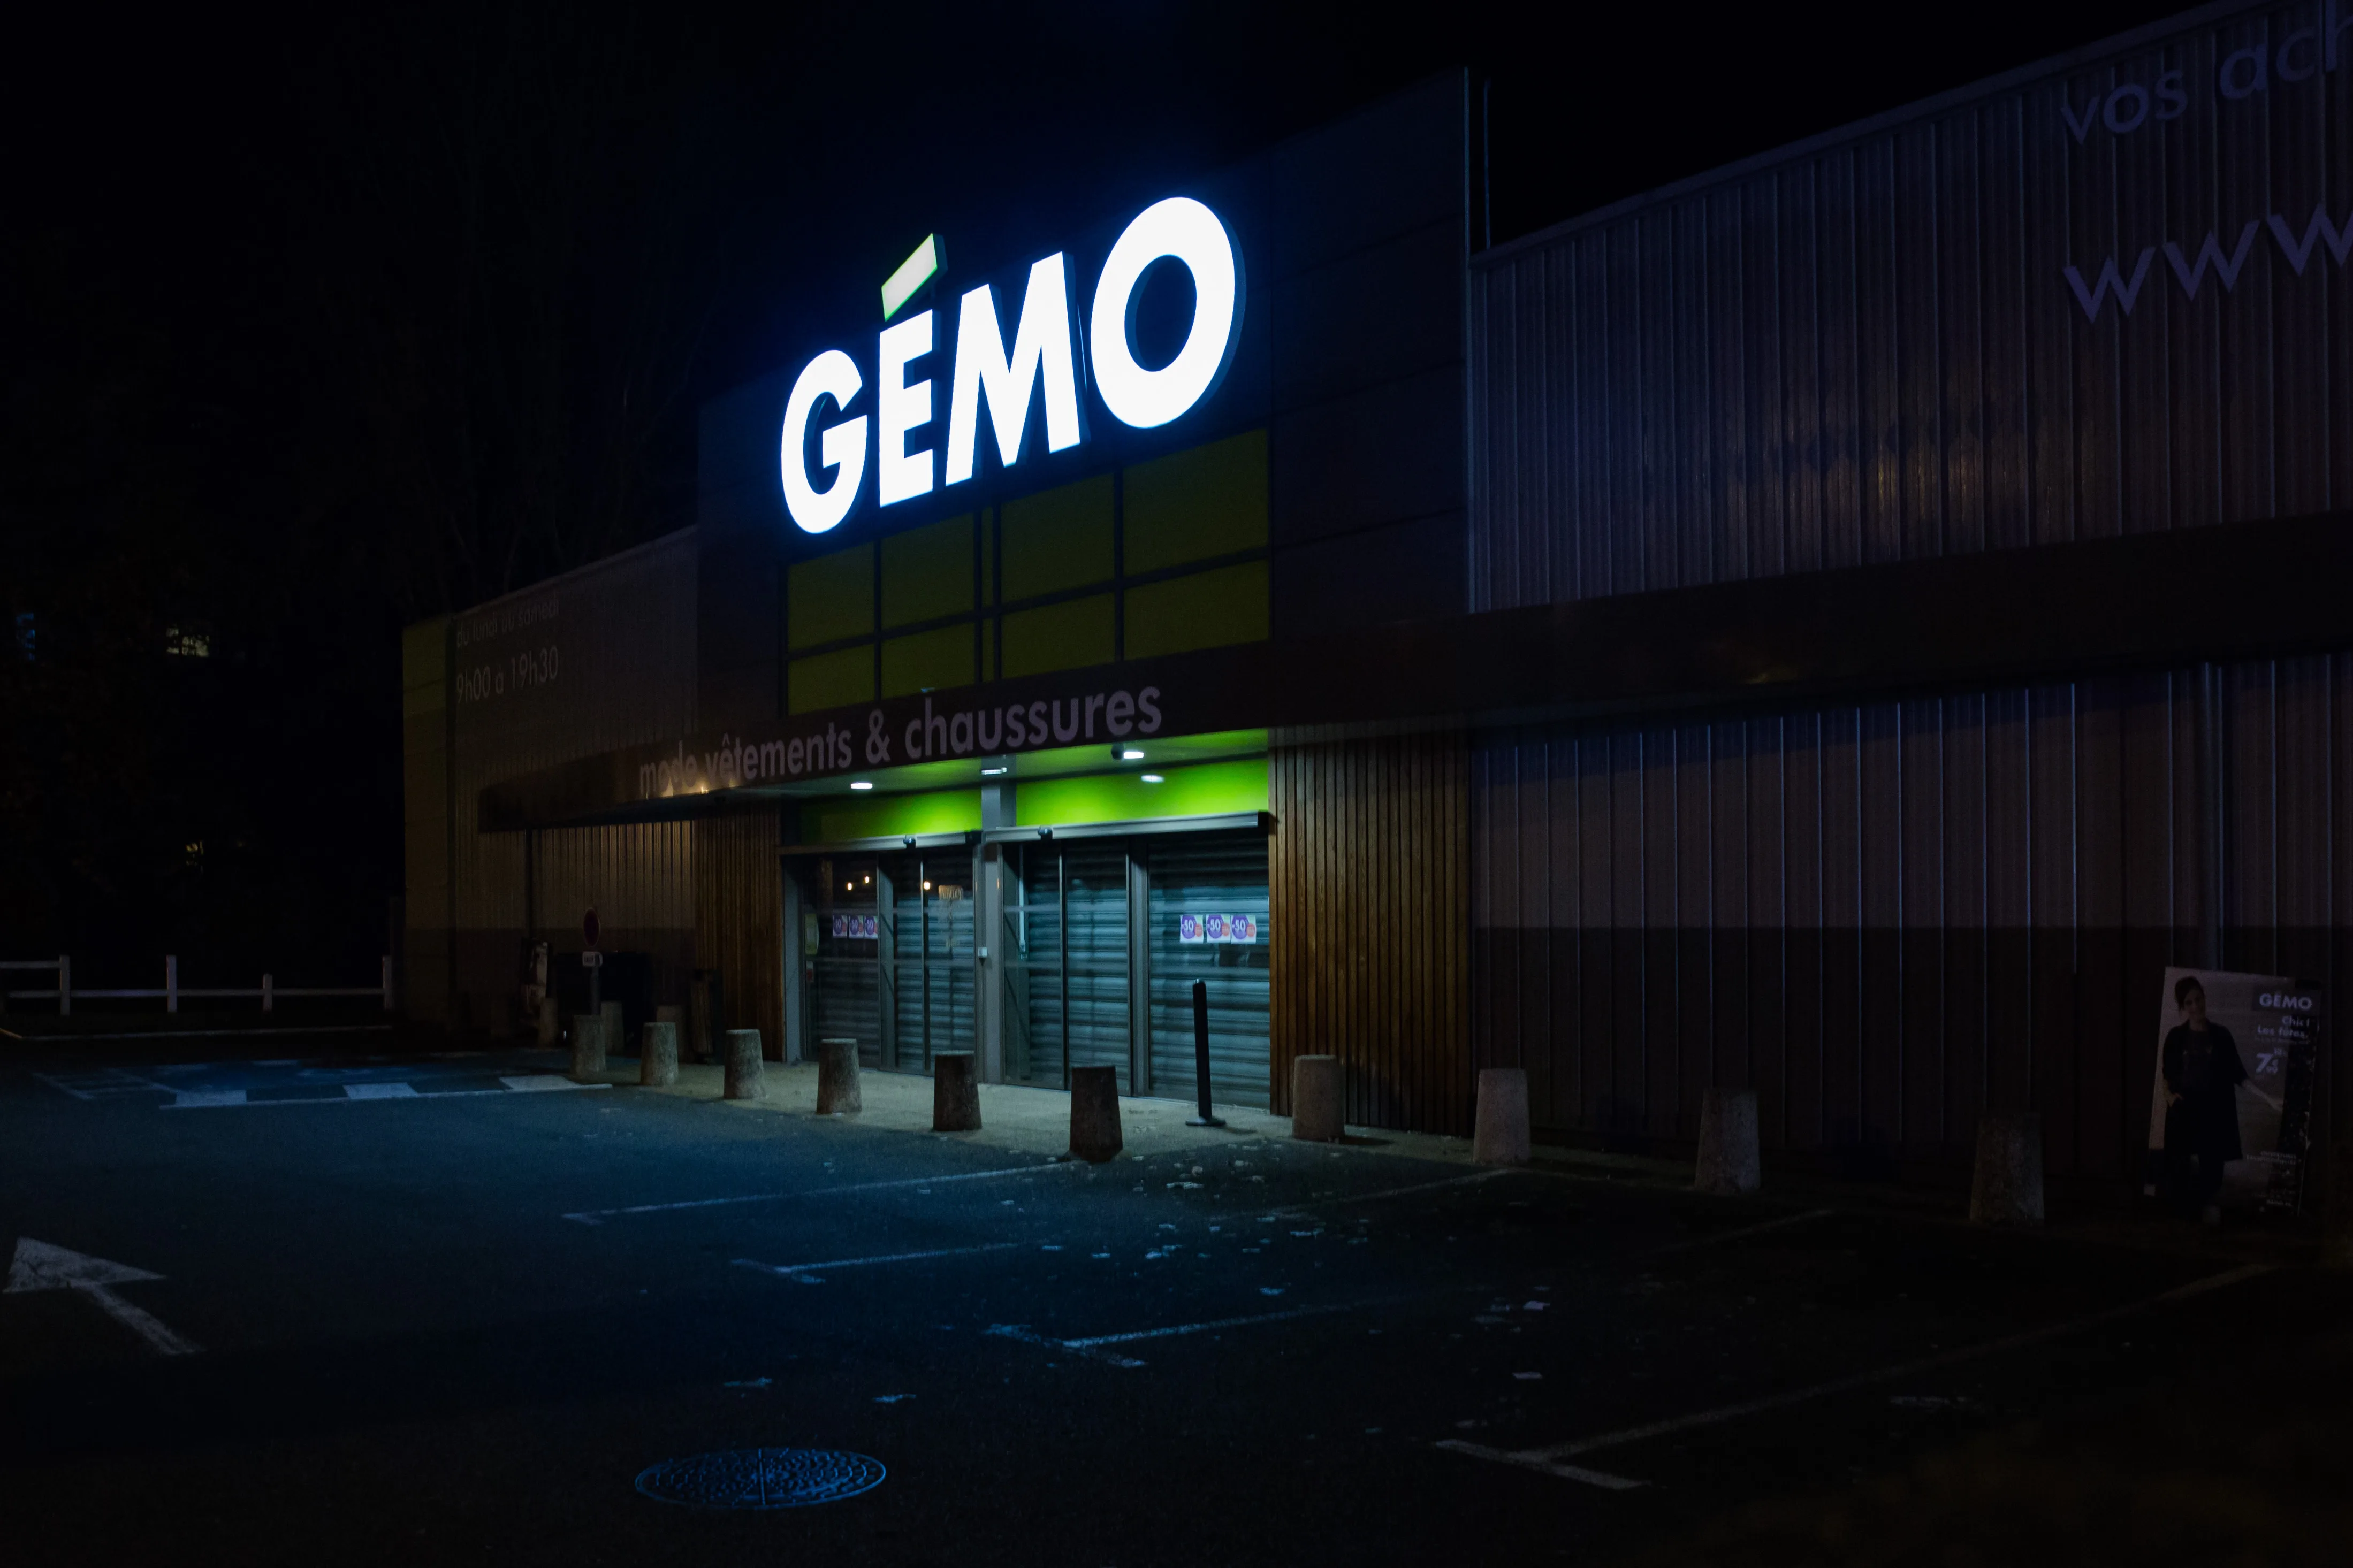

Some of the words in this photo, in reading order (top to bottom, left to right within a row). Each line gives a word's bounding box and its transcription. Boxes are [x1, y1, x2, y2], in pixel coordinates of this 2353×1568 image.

[2060, 70, 2188, 145] vos
[781, 197, 1240, 534] GÉMO
[456, 666, 491, 704] 9h00
[511, 645, 559, 691] 19h30
[639, 739, 697, 798] mode
[704, 721, 852, 789] vêtements
[865, 707, 891, 765] &
[904, 686, 1162, 761] chaussures
